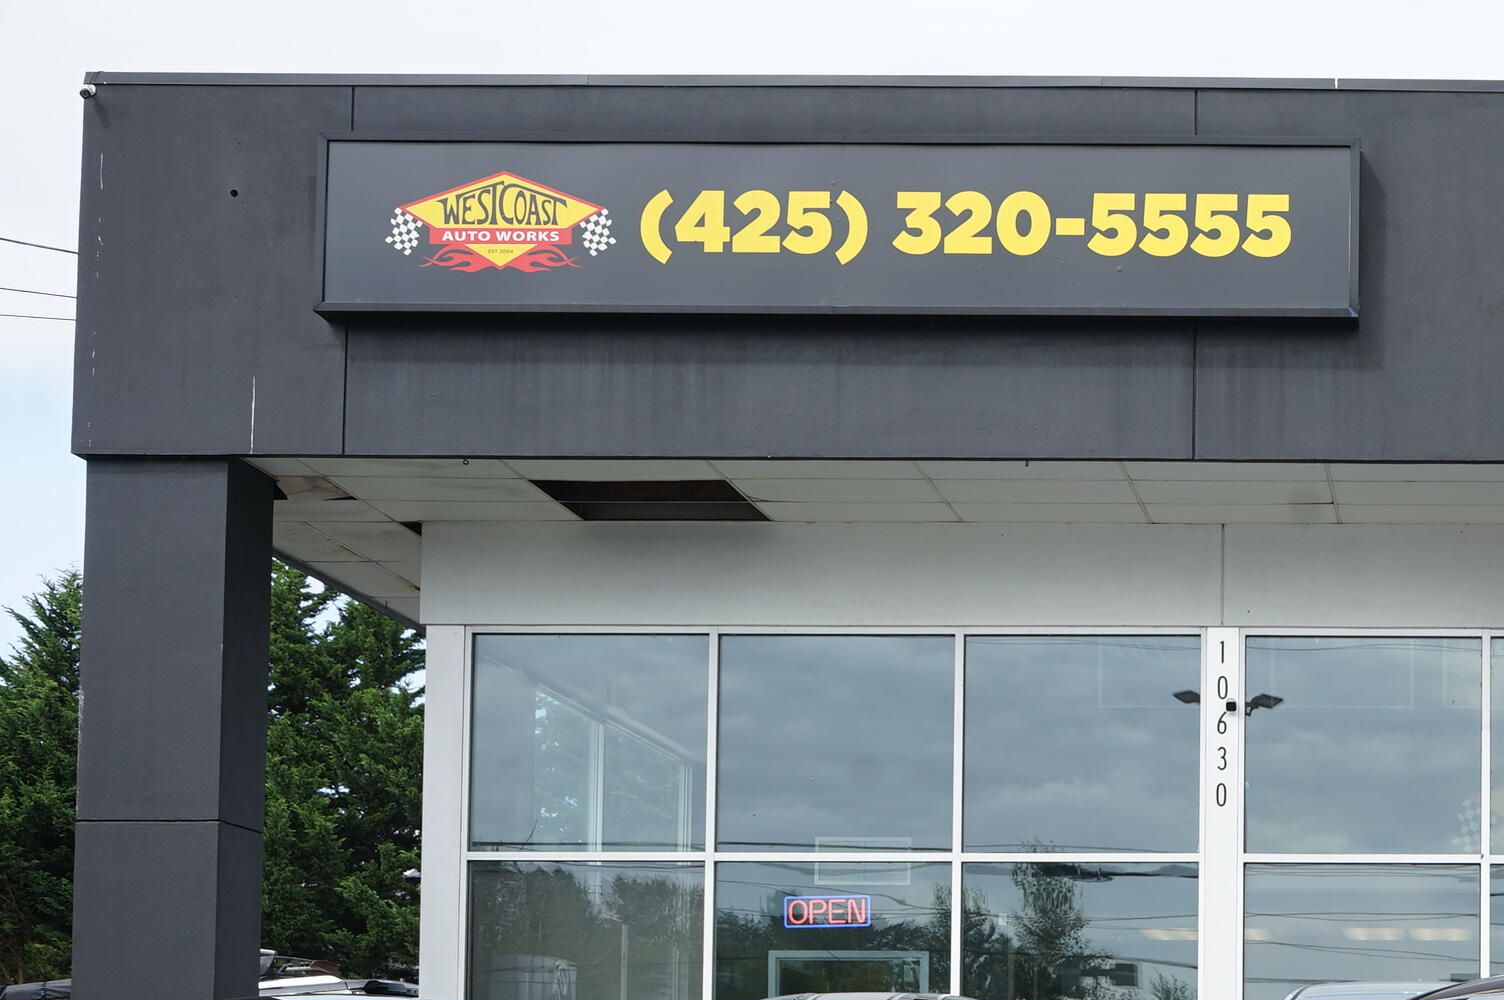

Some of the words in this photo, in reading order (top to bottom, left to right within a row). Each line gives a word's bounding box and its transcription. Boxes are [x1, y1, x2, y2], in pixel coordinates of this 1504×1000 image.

[442, 231, 490, 242] AUTO
[496, 231, 560, 242] WORKS
[640, 189, 869, 266] (425)
[891, 190, 1292, 258] 320-5555
[1216, 641, 1228, 807] 10630
[787, 899, 866, 925] OPEN
